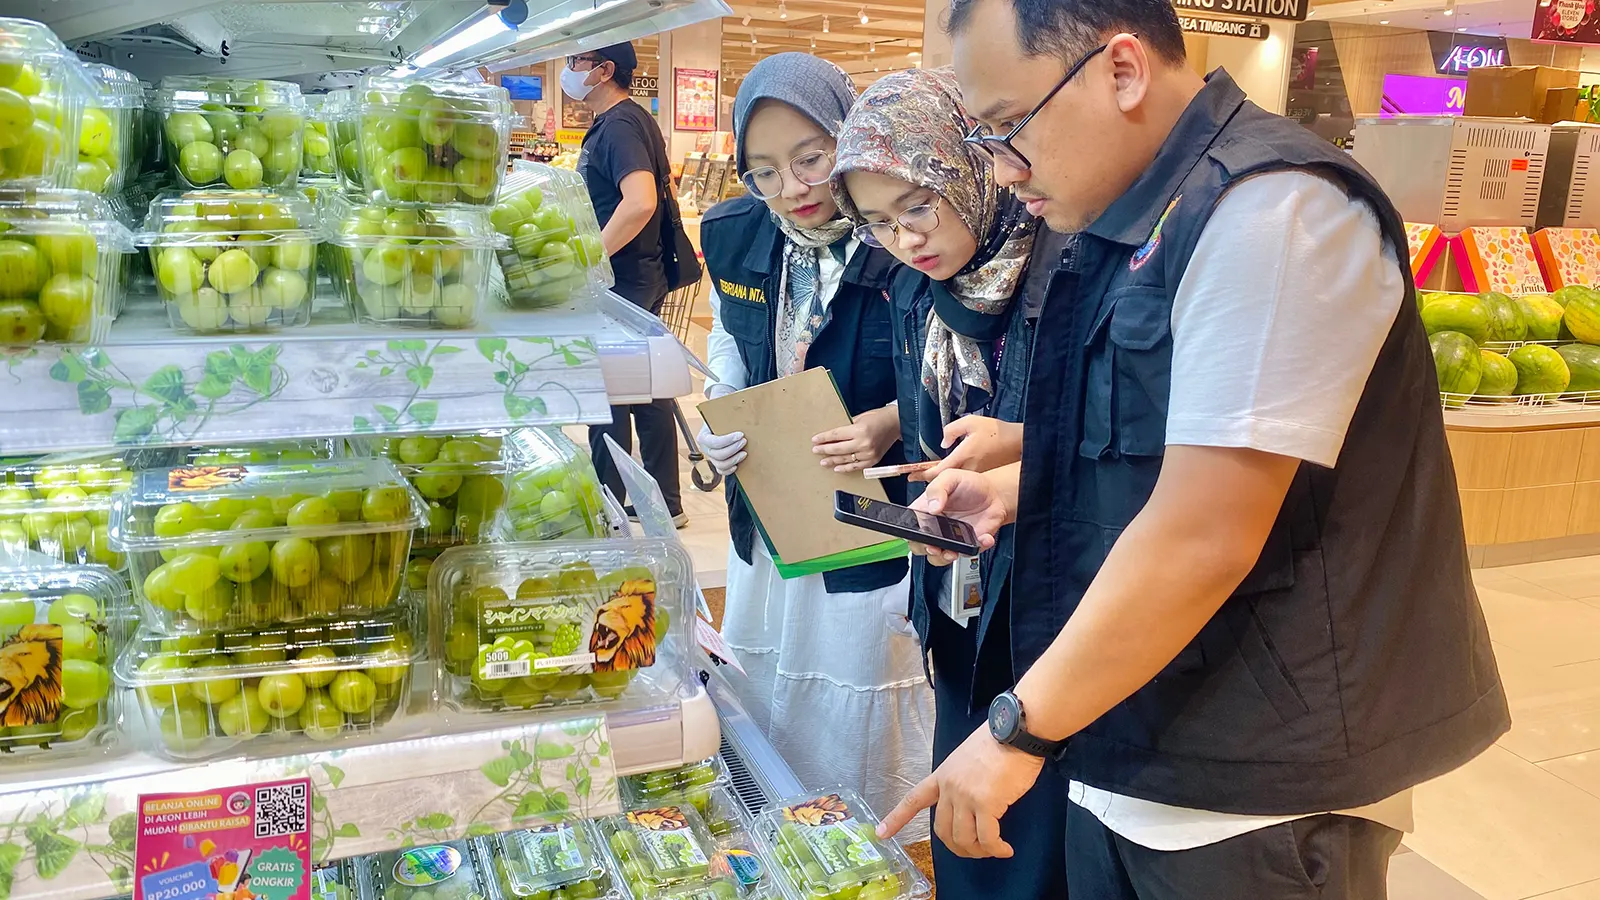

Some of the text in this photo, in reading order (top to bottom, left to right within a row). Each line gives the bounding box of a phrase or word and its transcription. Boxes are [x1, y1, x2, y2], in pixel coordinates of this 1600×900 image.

[1221, 0, 1297, 17] STATION
[1199, 20, 1246, 35] TIMBANG
[633, 89, 648, 97] IKAN
[1521, 283, 1545, 293] fruits
[145, 798, 219, 812] BELANJA ONLINE
[145, 811, 207, 824] DI AEON LEBIH
[144, 819, 249, 836] MUDAH DIBANTU RAISA!
[257, 862, 295, 872] GRATIS
[158, 871, 193, 886] VOUCHER
[253, 876, 294, 887] ONGKIR
[147, 879, 206, 900] RP20.000
